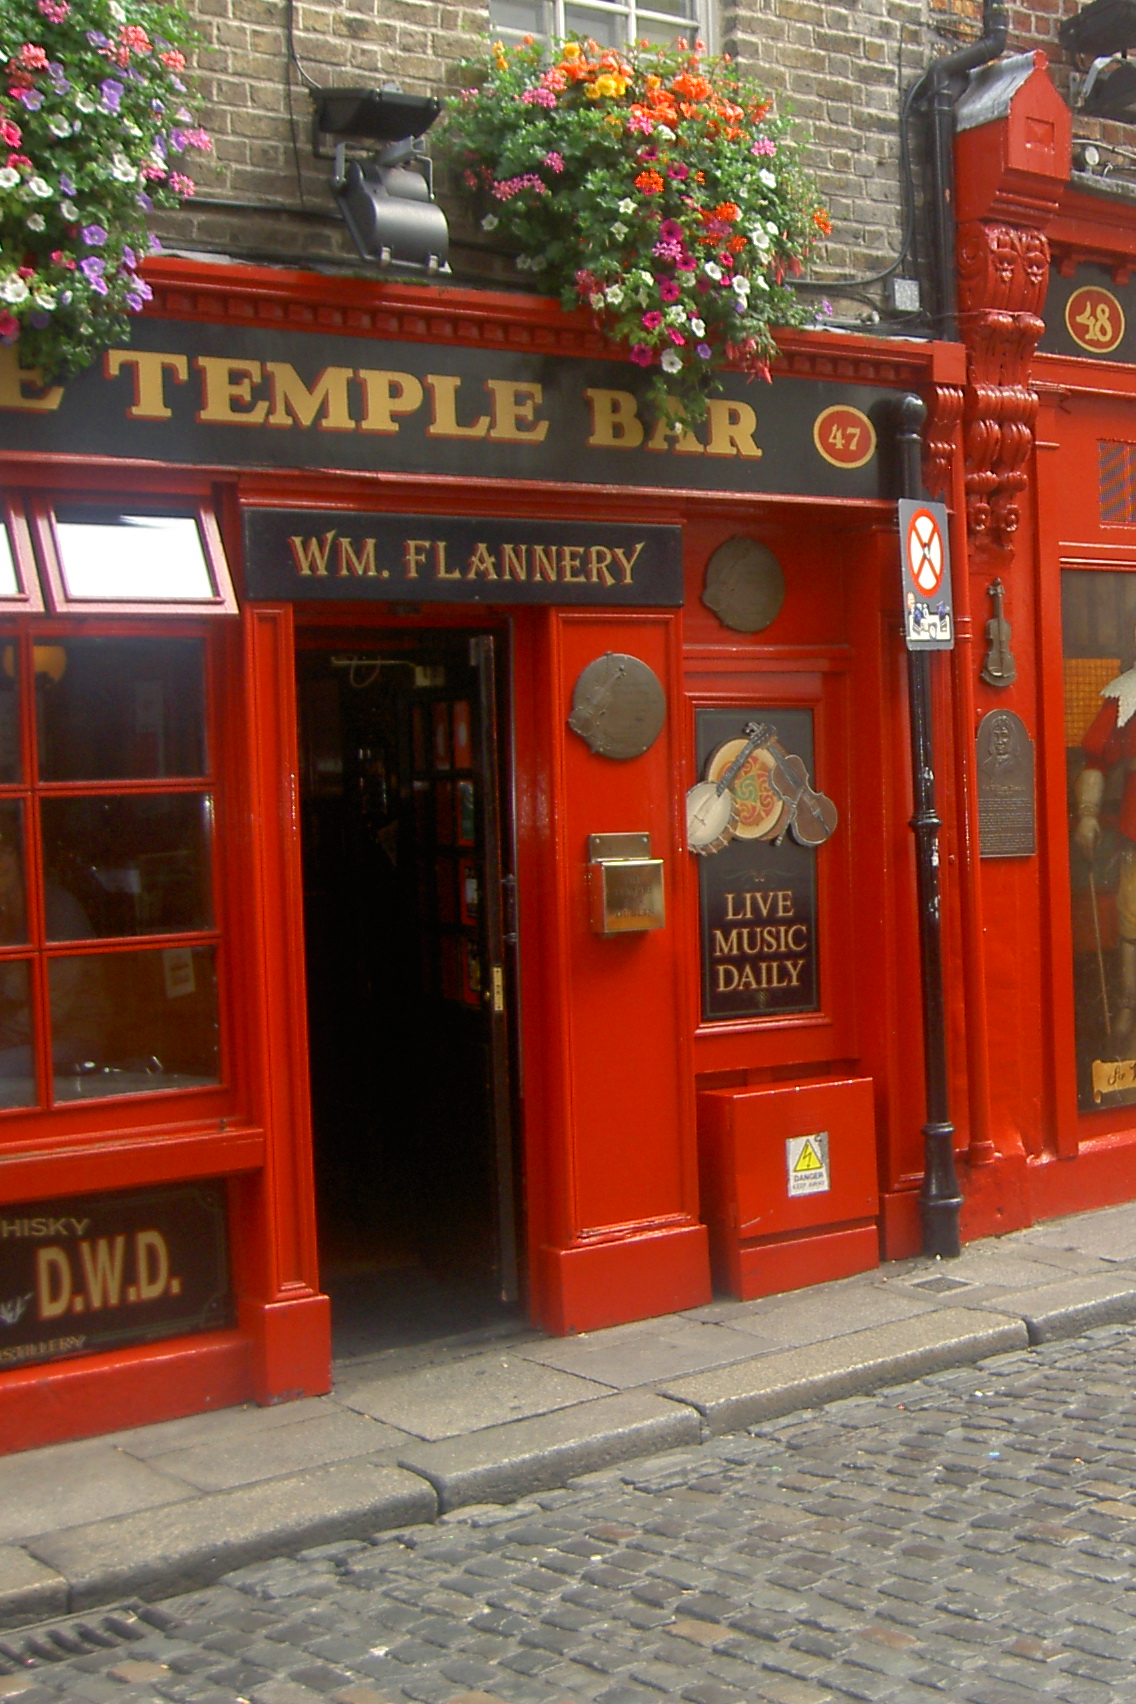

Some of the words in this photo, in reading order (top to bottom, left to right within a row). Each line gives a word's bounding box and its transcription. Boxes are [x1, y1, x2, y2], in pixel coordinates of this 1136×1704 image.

[1075, 301, 1112, 341] 48
[104, 349, 550, 444] TEMPLE
[584, 388, 763, 460] BAR
[829, 424, 862, 451] 47
[288, 530, 389, 579] WM.
[405, 540, 646, 588] FLANNERY
[725, 890, 794, 920] LIVE
[713, 925, 808, 956] MUSIC
[716, 960, 805, 992] DAILY
[794, 1172, 824, 1182] DANGER
[37, 1228, 183, 1321] D.W.D.
[0, 1335, 86, 1361] STILLERY
